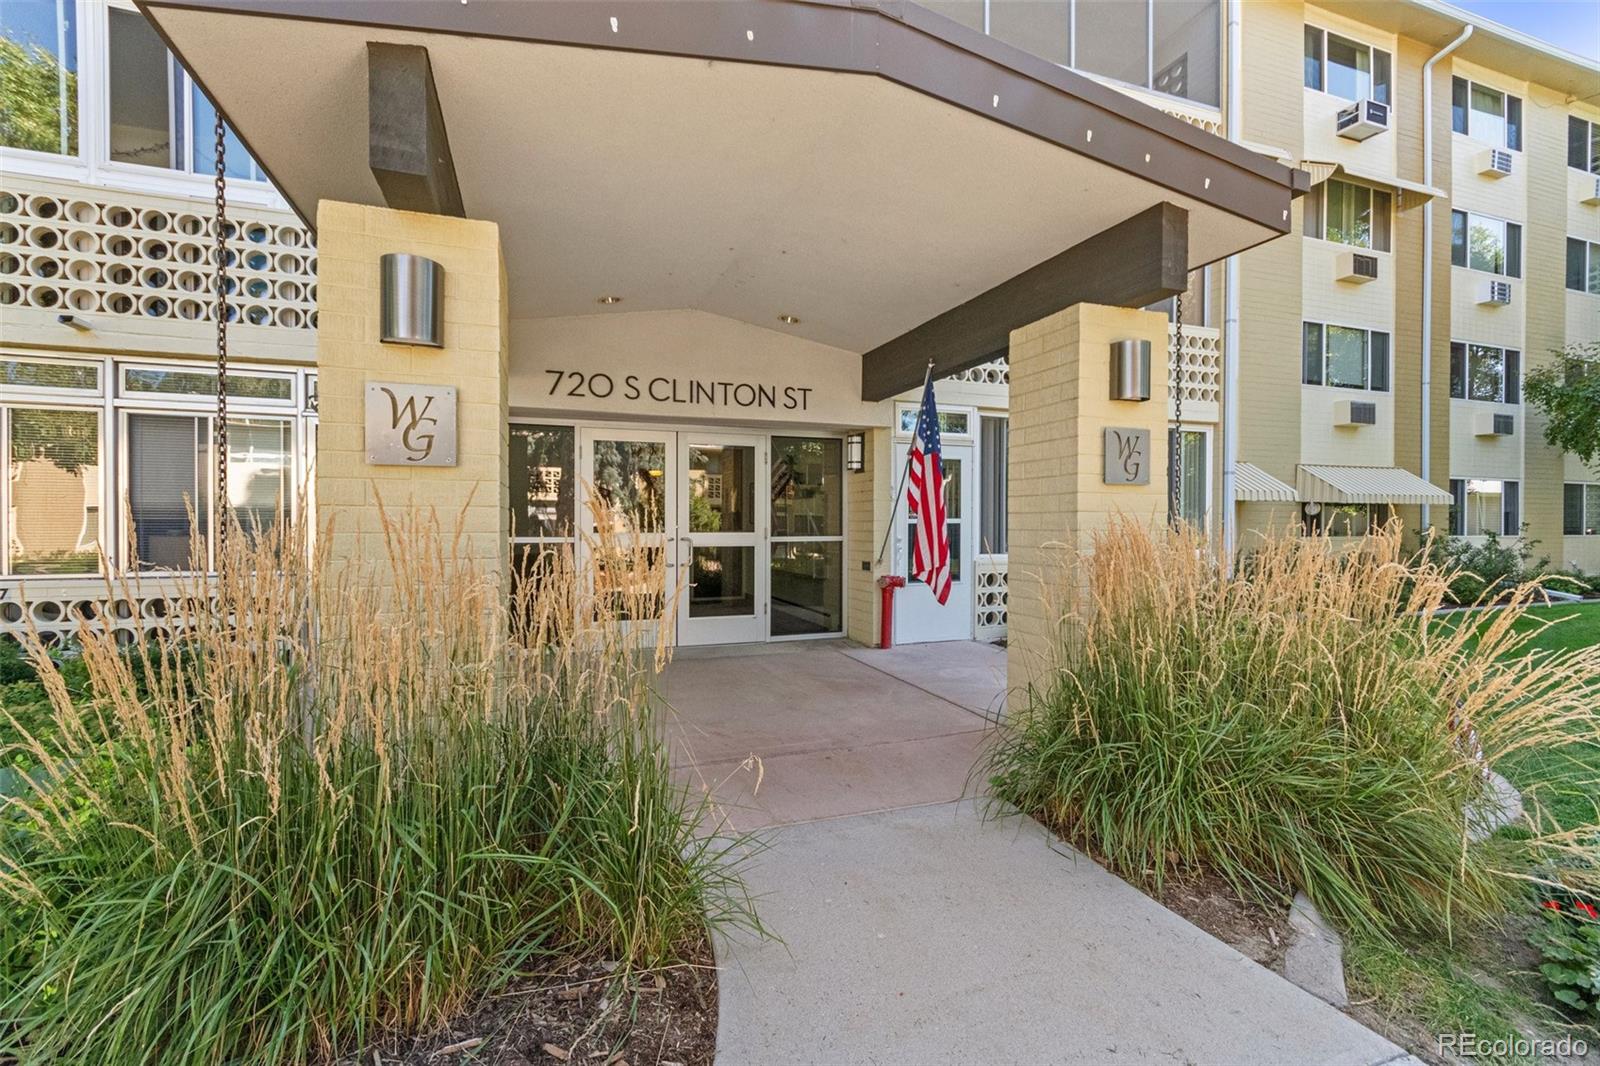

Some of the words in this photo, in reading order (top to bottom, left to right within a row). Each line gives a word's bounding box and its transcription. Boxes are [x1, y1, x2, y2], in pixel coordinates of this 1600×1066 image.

[545, 370, 614, 398] 720
[624, 375, 641, 400] S
[648, 377, 776, 408] CLINTON
[783, 386, 813, 410] ST
